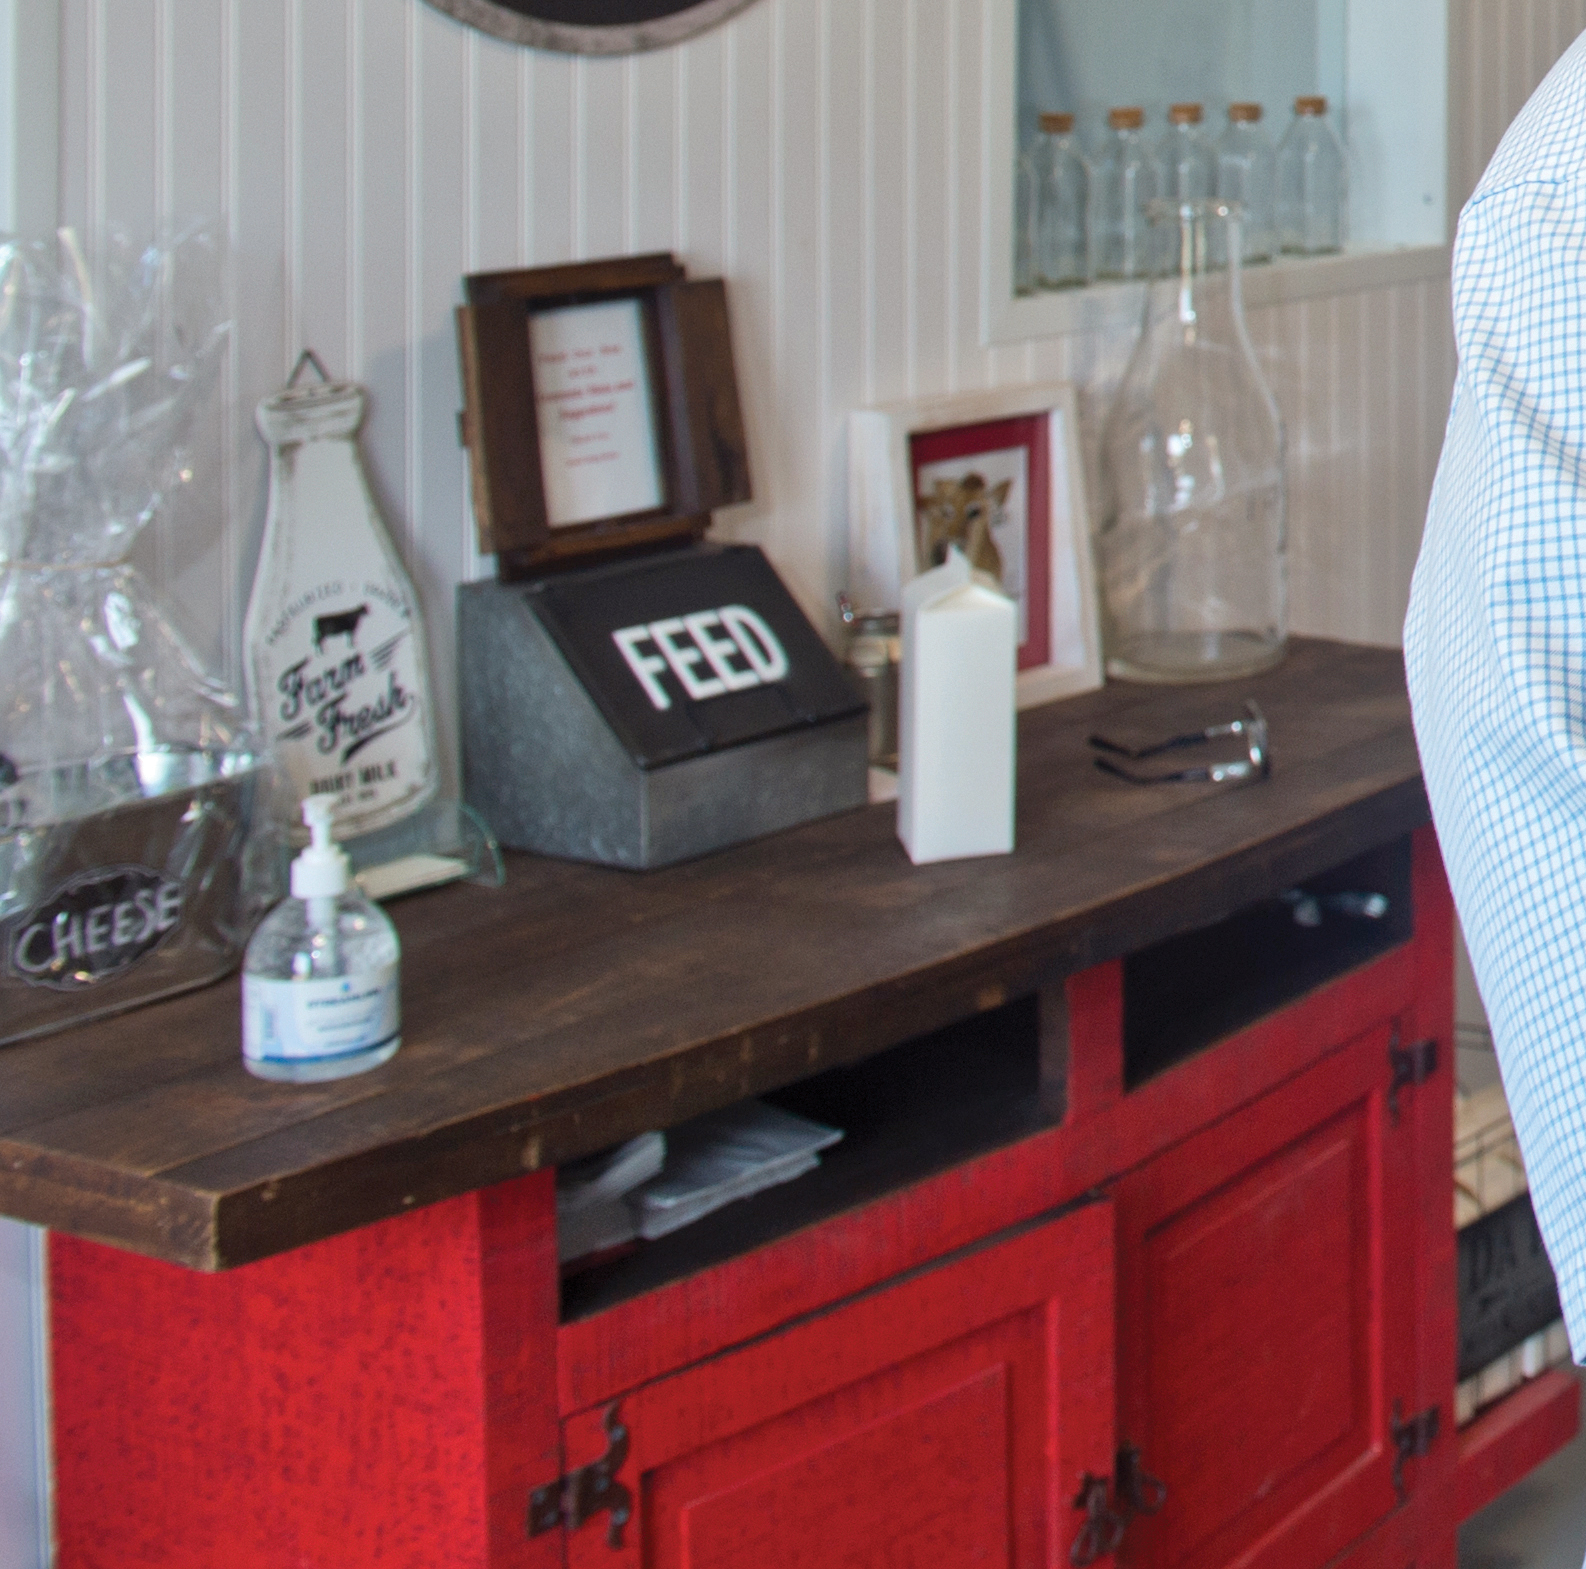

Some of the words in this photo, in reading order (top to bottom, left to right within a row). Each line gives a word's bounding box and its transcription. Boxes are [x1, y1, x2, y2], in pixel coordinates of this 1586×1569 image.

[277, 653, 366, 722] Farm
[615, 604, 789, 711] FEED
[316, 669, 411, 755] Fresh
[15, 881, 184, 972] CHEESE
